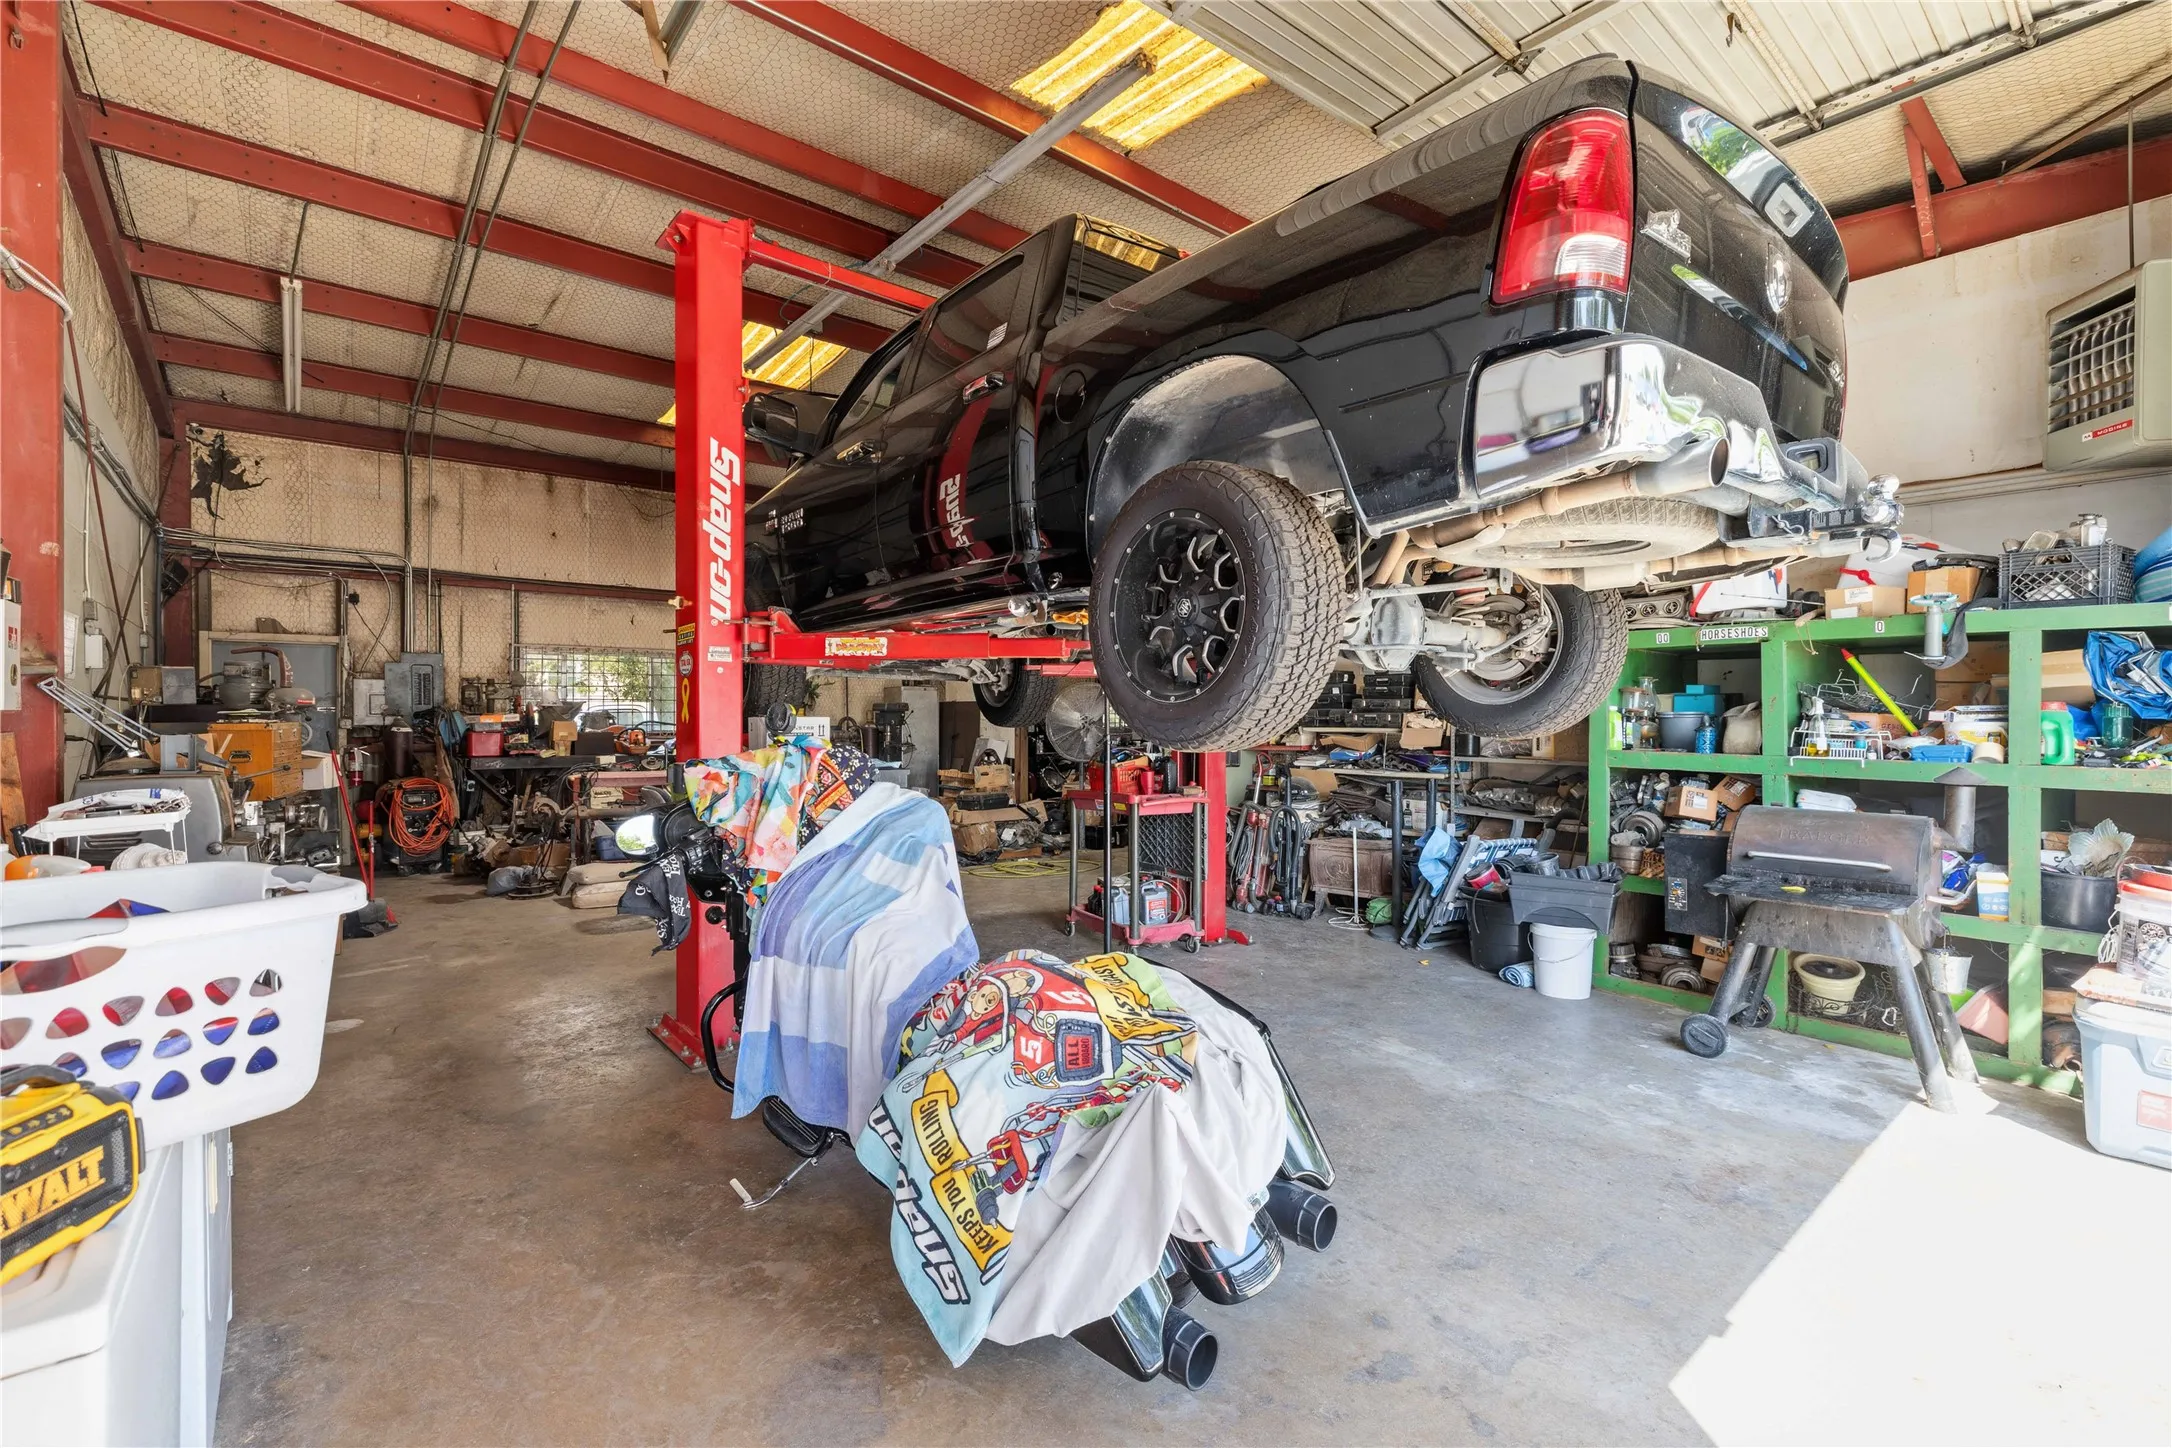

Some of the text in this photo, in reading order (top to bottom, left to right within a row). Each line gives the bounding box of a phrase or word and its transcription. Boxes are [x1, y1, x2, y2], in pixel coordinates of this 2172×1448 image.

[2096, 422, 2128, 435] MODINE
[702, 437, 740, 622] Snap-on
[1701, 626, 1768, 640] HORSESHOES
[1068, 1040, 1079, 1066] ALL
[0, 1156, 105, 1232] WALT
[919, 1099, 1000, 1254] KEEPS YOU ROLLING
